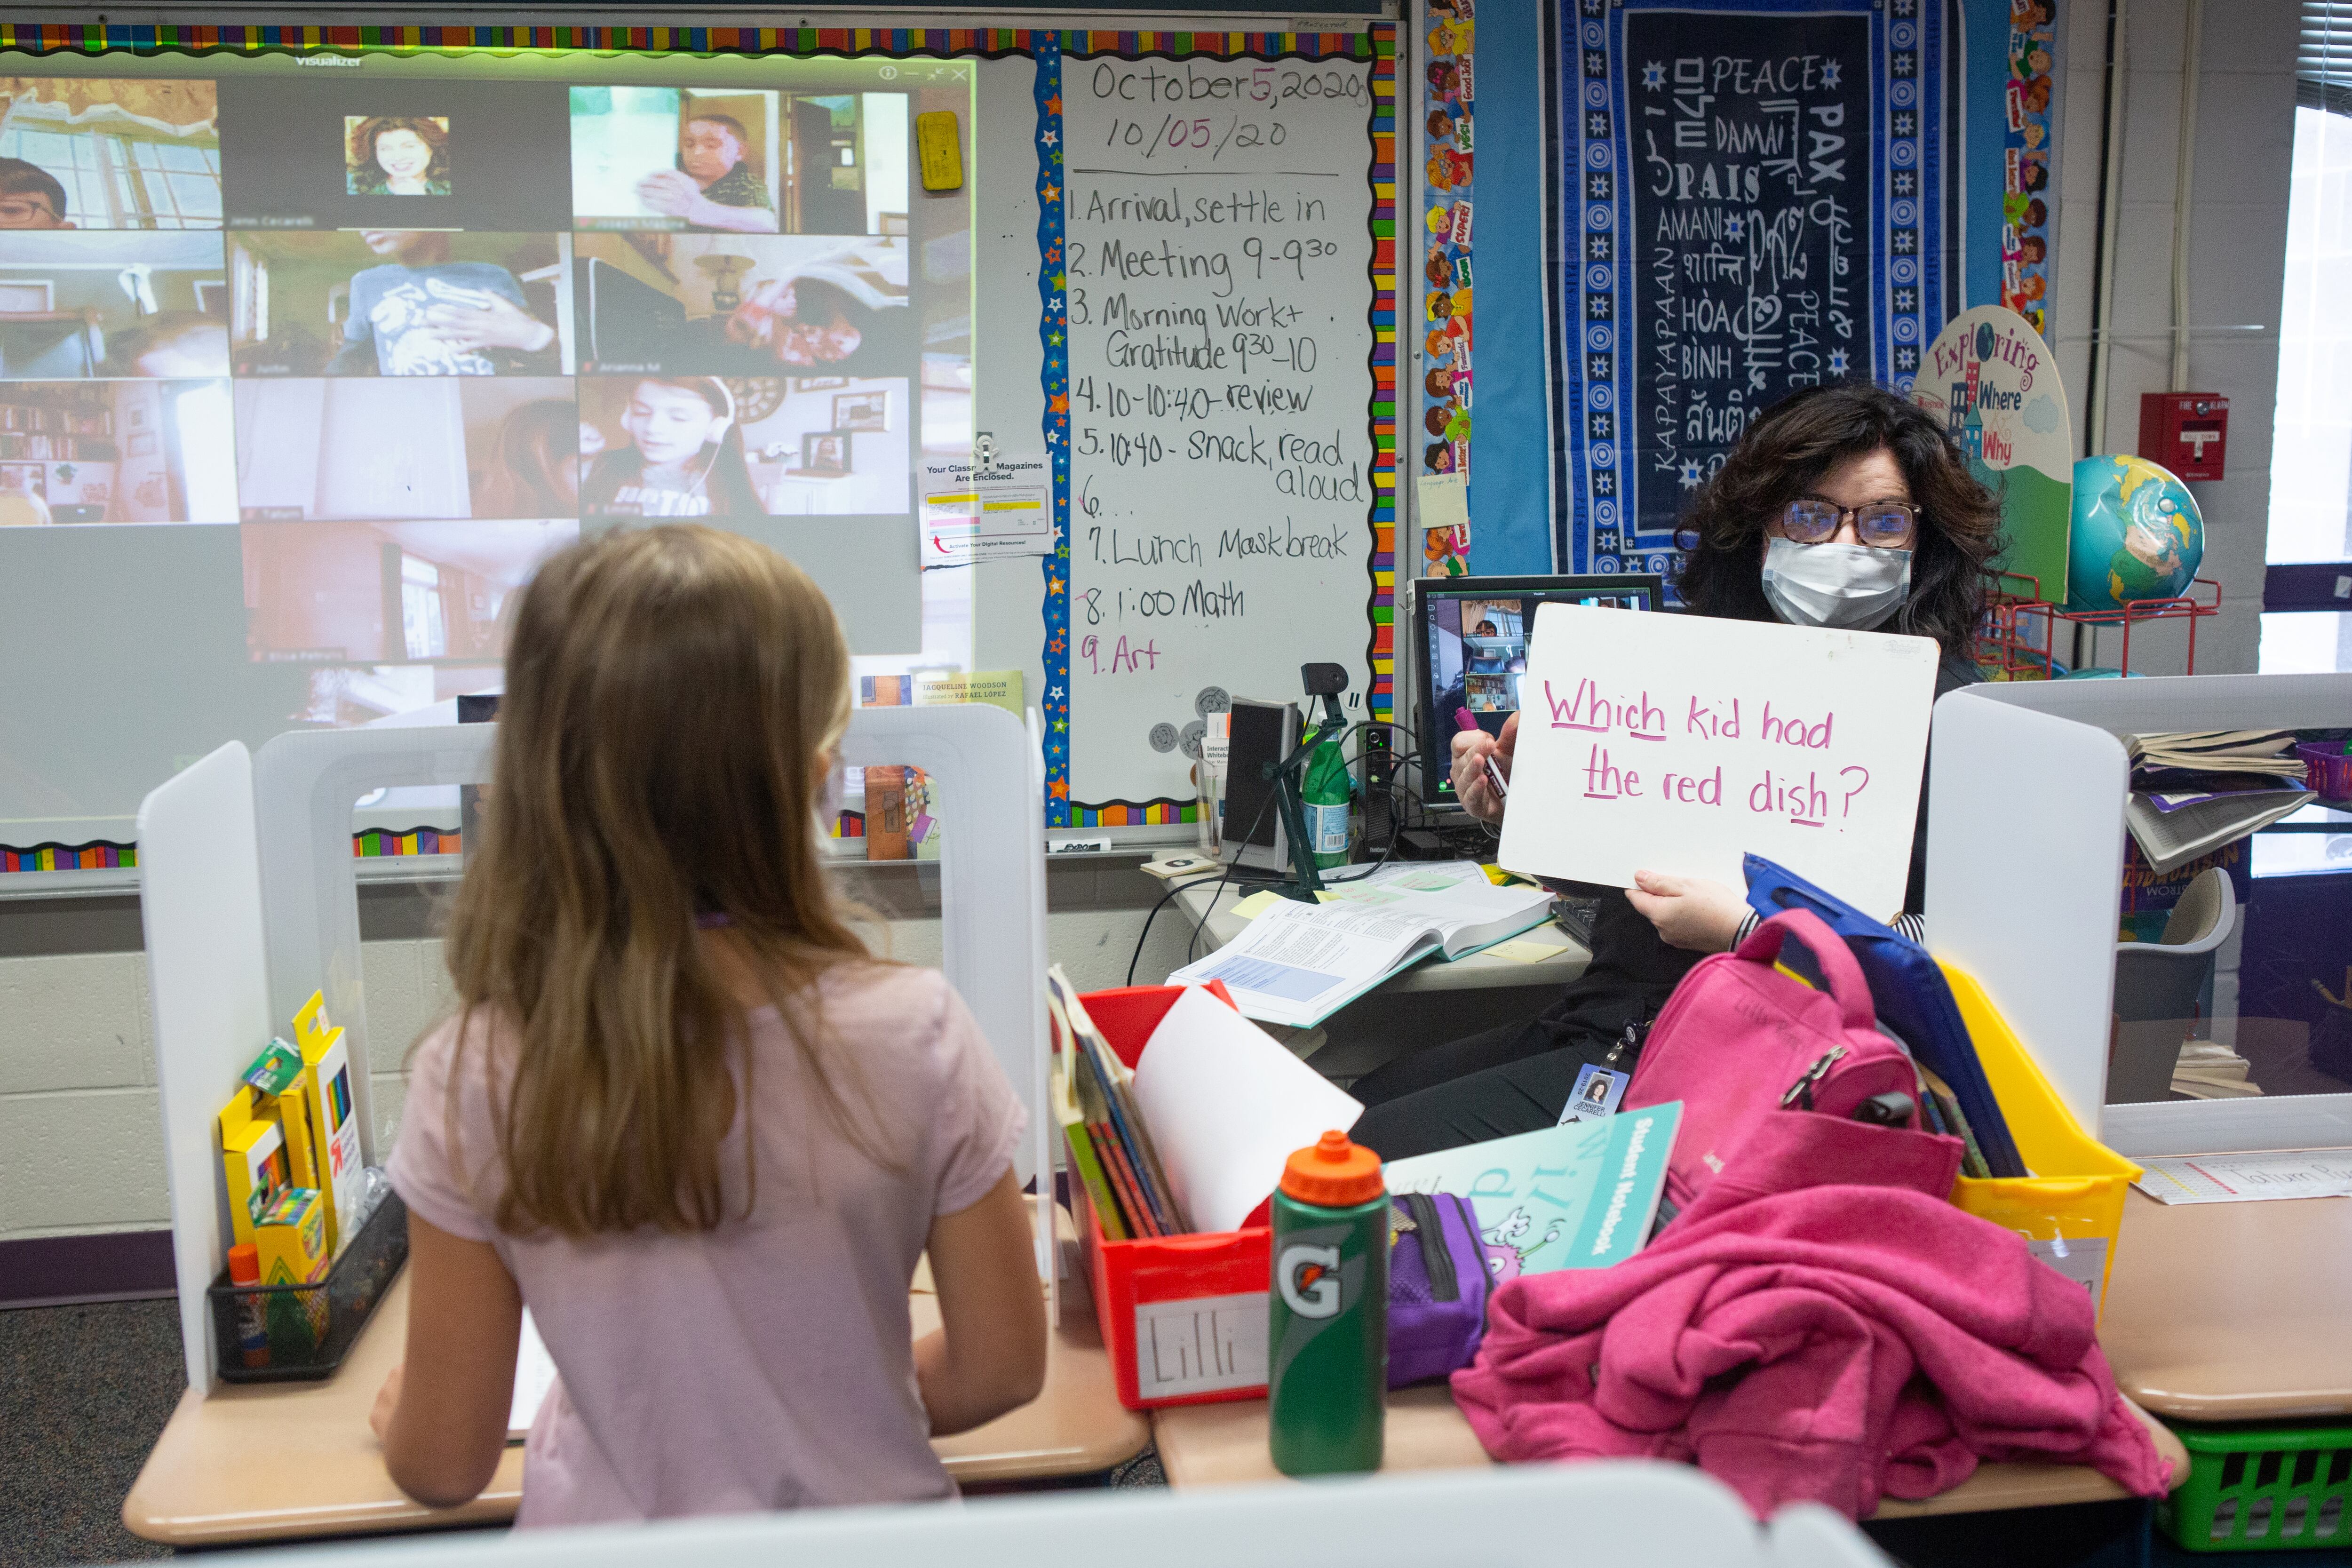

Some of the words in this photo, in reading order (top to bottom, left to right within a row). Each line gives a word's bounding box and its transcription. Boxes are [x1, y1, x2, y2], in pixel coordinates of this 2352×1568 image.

[1712, 56, 1820, 93] PEACE
[1809, 103, 1846, 183] PAX
[1297, 192, 1325, 221] in
[1657, 207, 1722, 240] AMANI
[1101, 239, 1233, 297] Meeting
[1103, 293, 1208, 336] Morning
[1107, 330, 1228, 371] Gratitude
[1787, 290, 1820, 388] PEACE
[1934, 322, 2040, 391] Exploring
[1654, 247, 1677, 471] KAPAYAPAAN
[1979, 381, 2022, 411] Where
[996, 462, 1043, 471] Magazines
[1279, 428, 1343, 466] read
[1983, 430, 2012, 466] Why
[1276, 461, 1364, 502] aloud
[1113, 528, 1202, 567] Lunch
[1183, 580, 1244, 619] Math
[1112, 635, 1162, 675] Art
[922, 683, 968, 692] JACQUELINE
[969, 681, 1007, 690] WOODSON
[984, 689, 1007, 698] LÓPEZ
[1544, 678, 1666, 740] Which
[1688, 695, 1740, 740] kid
[1762, 700, 1834, 749] had
[1581, 743, 1644, 800] the
[1663, 765, 1722, 806] red
[1063, 843, 1090, 852] EXPO
[1578, 1073, 1590, 1095] 2019-20
[1573, 1105, 1606, 1117] CECARELLI
[1577, 1101, 1605, 1113] JENNIFER
[1619, 1117, 1654, 1180] Student
[1591, 1181, 1635, 1256] Notebook
[1278, 1245, 1341, 1318] G
